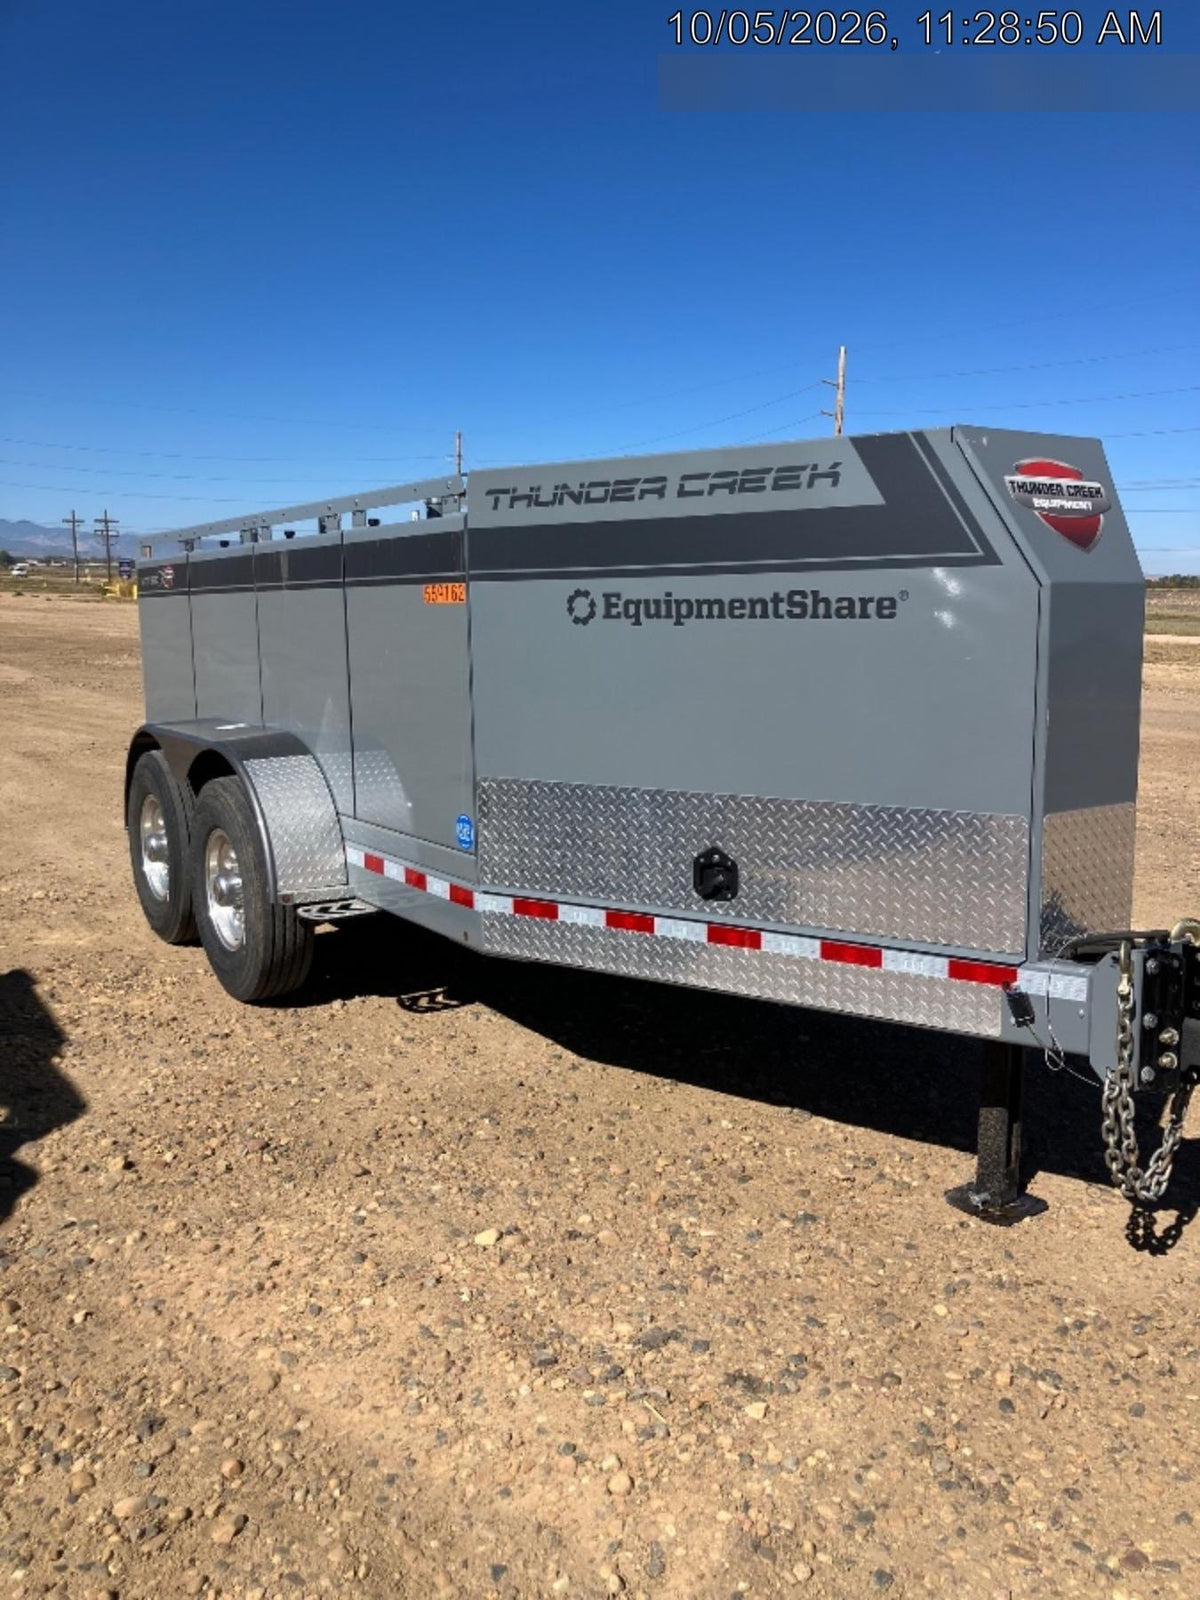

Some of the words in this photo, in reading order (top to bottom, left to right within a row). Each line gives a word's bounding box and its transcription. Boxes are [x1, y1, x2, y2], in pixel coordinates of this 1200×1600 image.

[485, 476, 668, 511] THUNDER
[677, 461, 842, 499] CREEK
[1008, 481, 1066, 497] THUNDER
[1066, 484, 1104, 499] CREEK
[1032, 498, 1093, 511] EQUIPMENT
